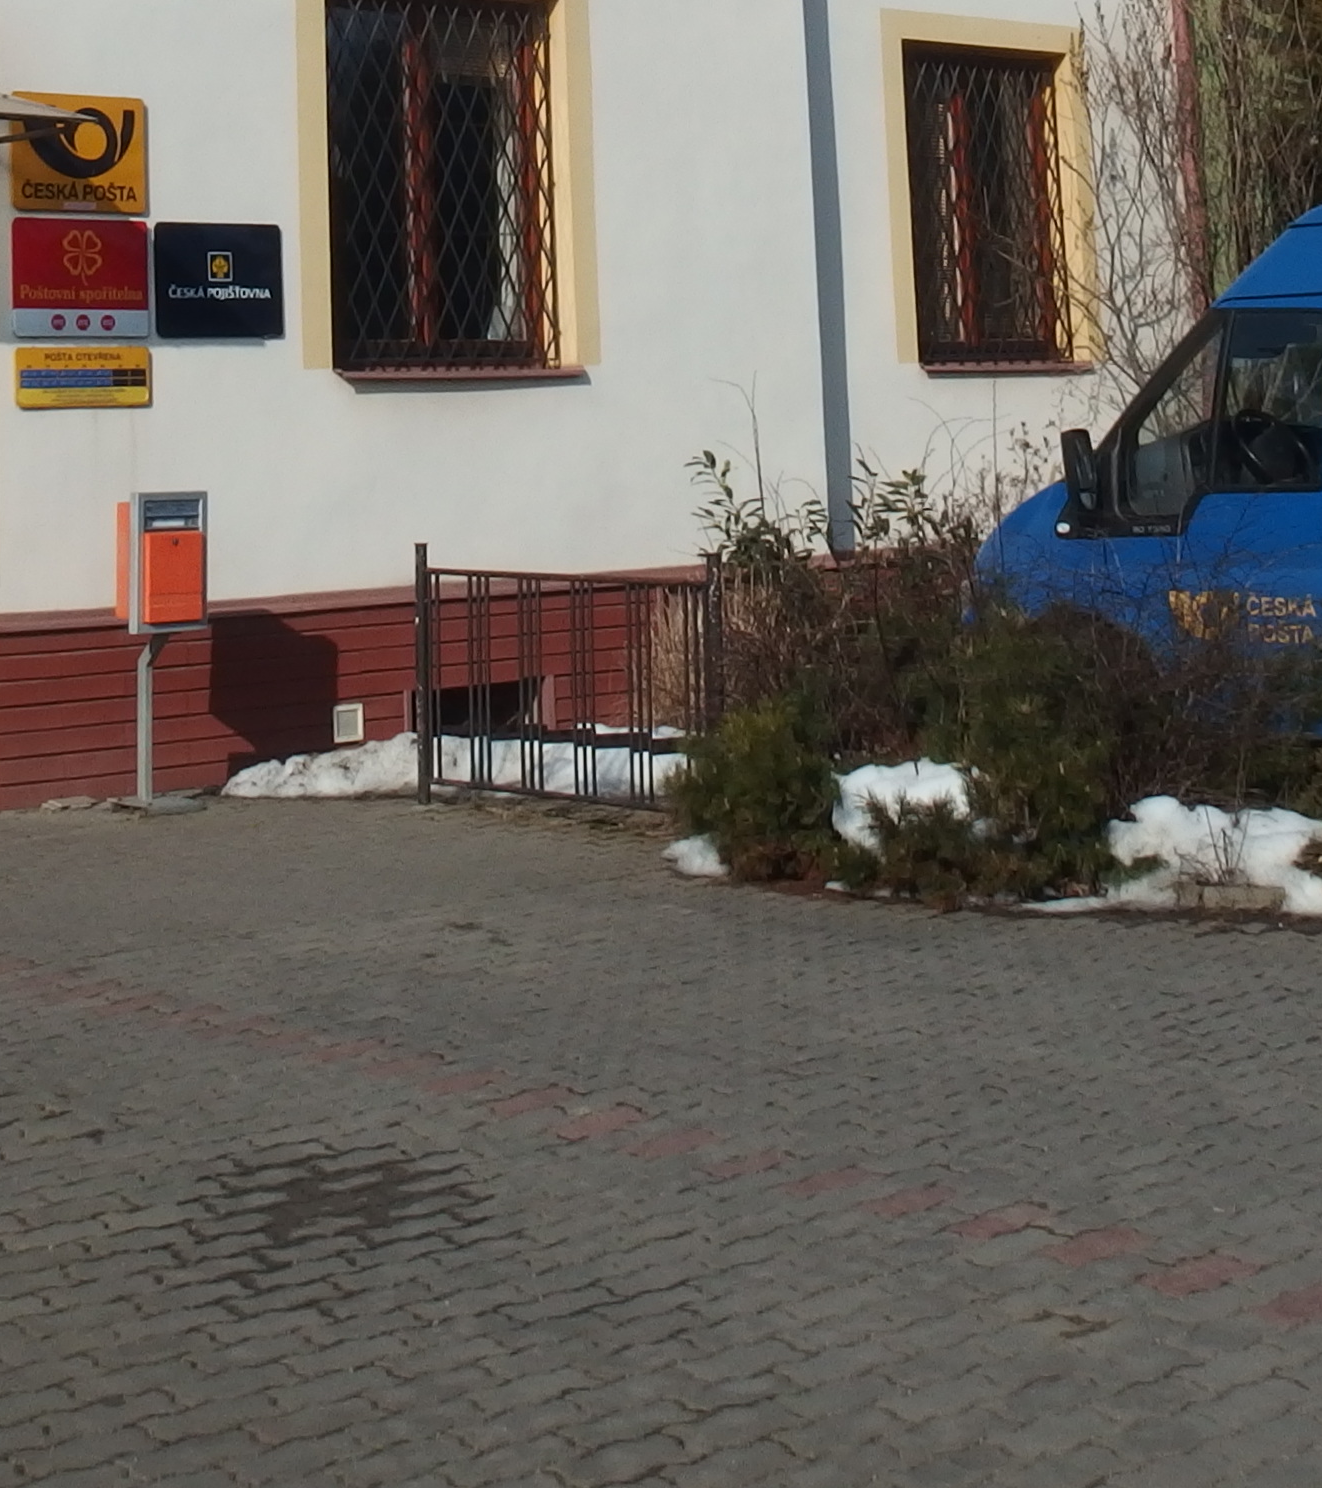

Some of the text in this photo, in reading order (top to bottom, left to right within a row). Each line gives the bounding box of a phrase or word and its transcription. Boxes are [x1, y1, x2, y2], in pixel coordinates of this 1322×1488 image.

[21, 179, 138, 202] ČESKÁ POŠTA
[20, 284, 143, 304] Poštovní spořitelna
[168, 283, 205, 299] ČESKÁ
